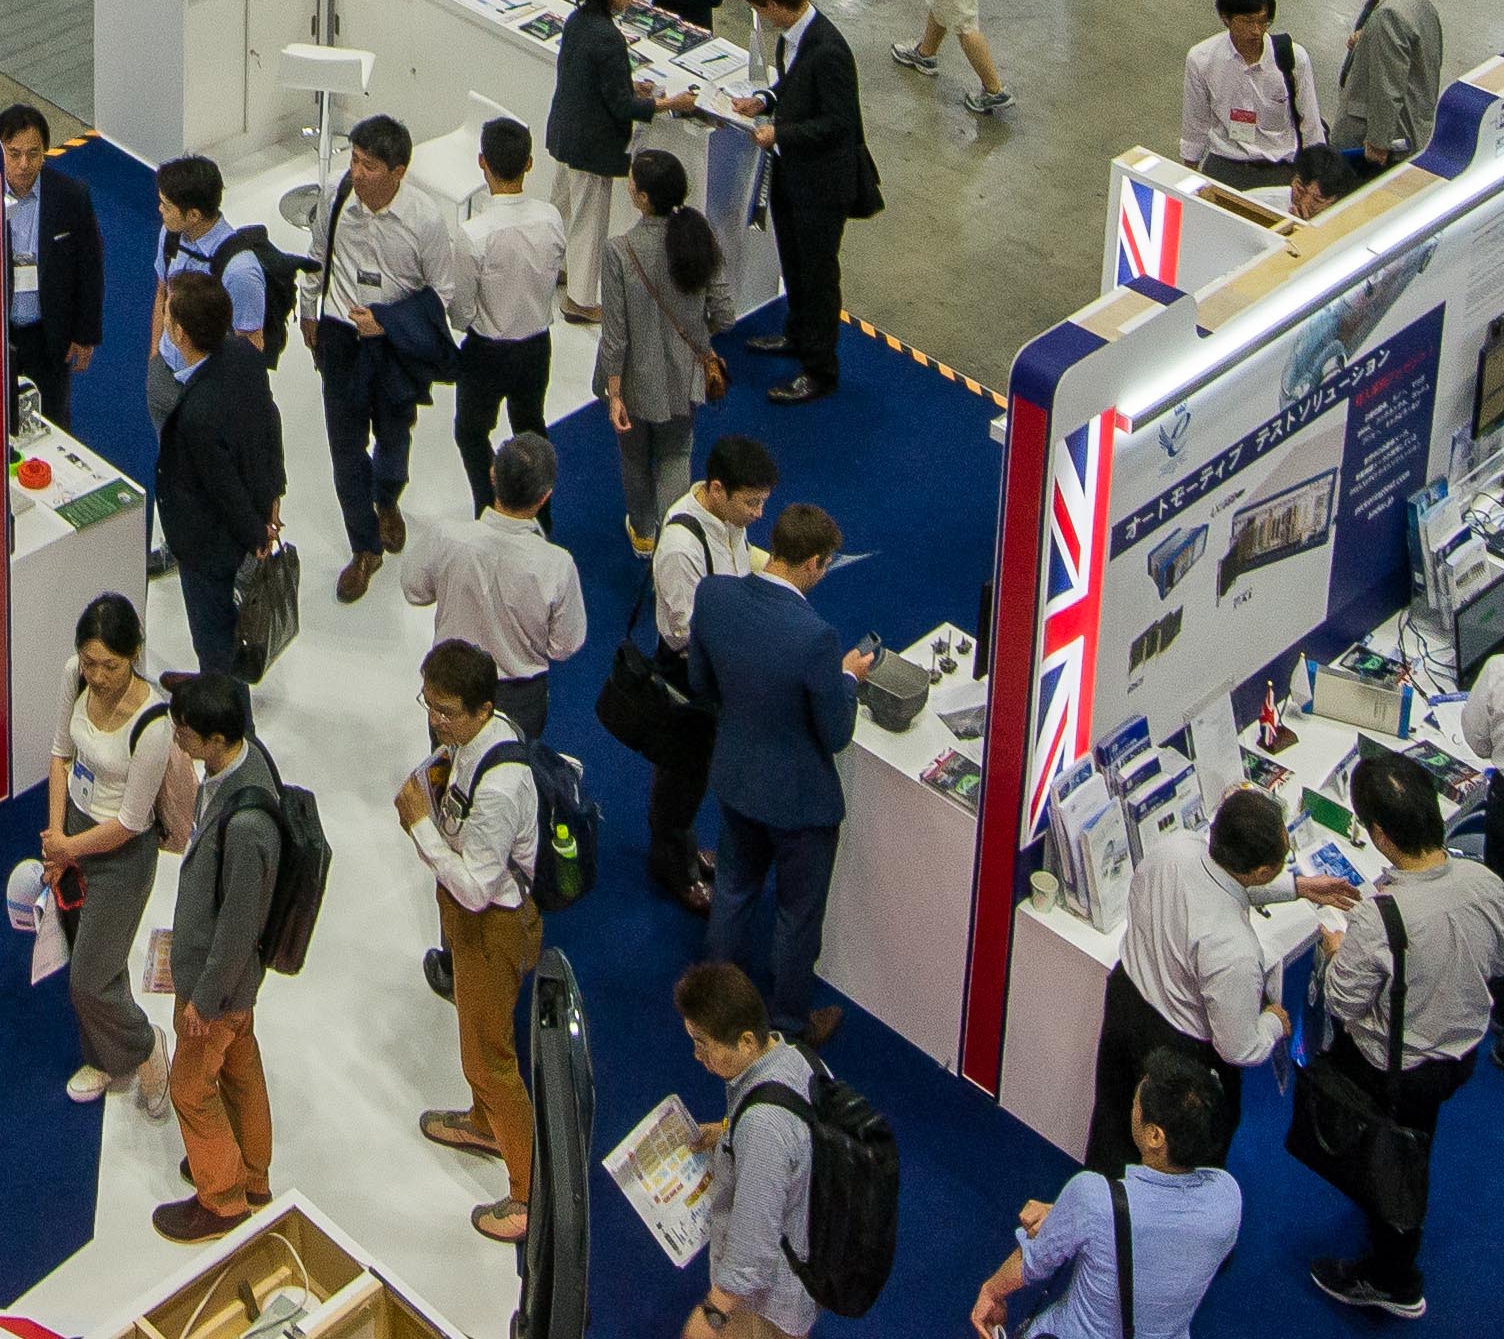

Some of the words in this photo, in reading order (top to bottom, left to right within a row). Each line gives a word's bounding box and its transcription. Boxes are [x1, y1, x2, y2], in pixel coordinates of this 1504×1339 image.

[1124, 450, 1244, 541] オートモーティブ
[1254, 348, 1392, 450] テストソリューション
